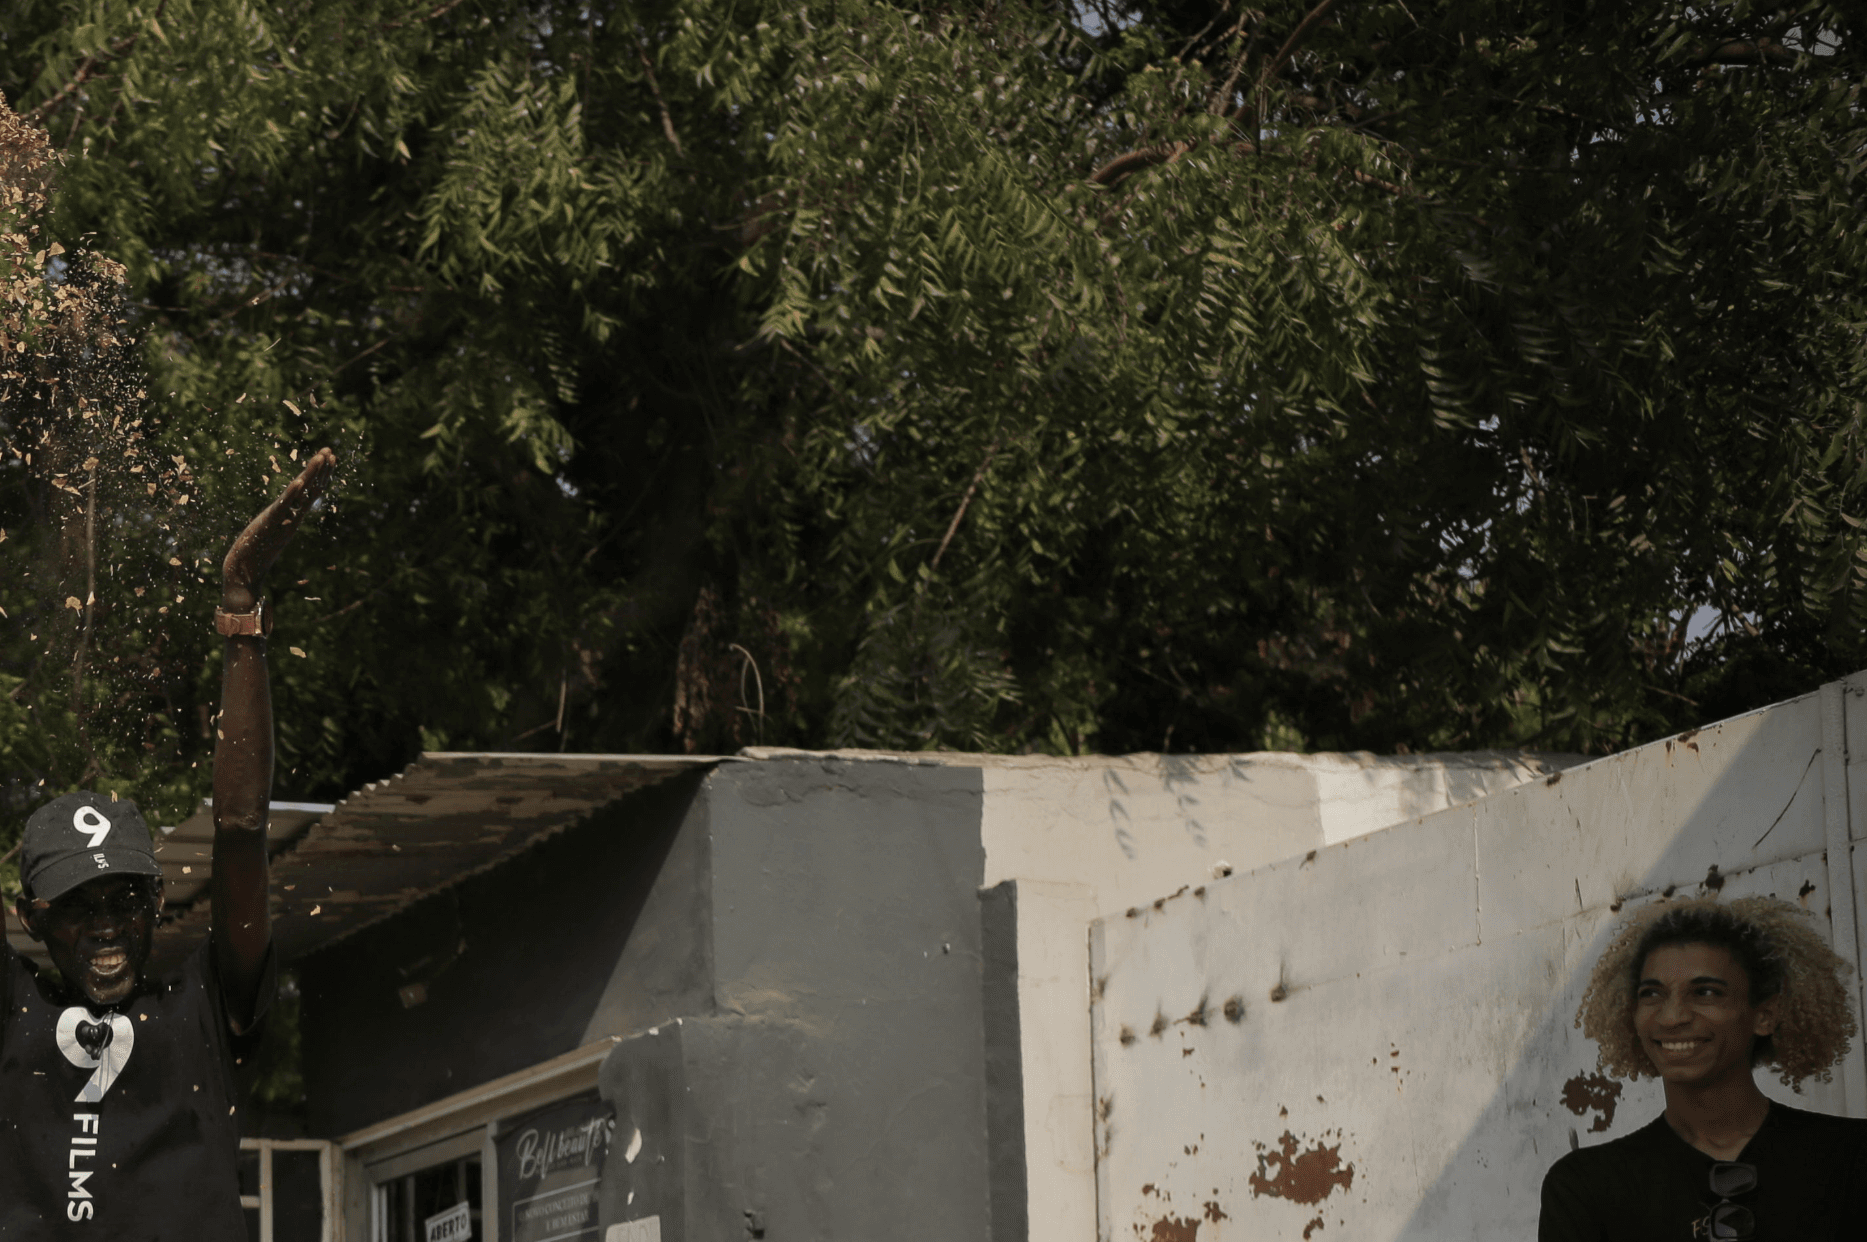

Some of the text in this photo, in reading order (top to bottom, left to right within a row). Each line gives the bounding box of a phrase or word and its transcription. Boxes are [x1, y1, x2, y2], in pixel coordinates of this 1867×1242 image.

[72, 805, 112, 849] 9
[55, 1006, 135, 1103] 9
[66, 1113, 99, 1222] FILMS
[430, 1213, 467, 1242] ABERTO
